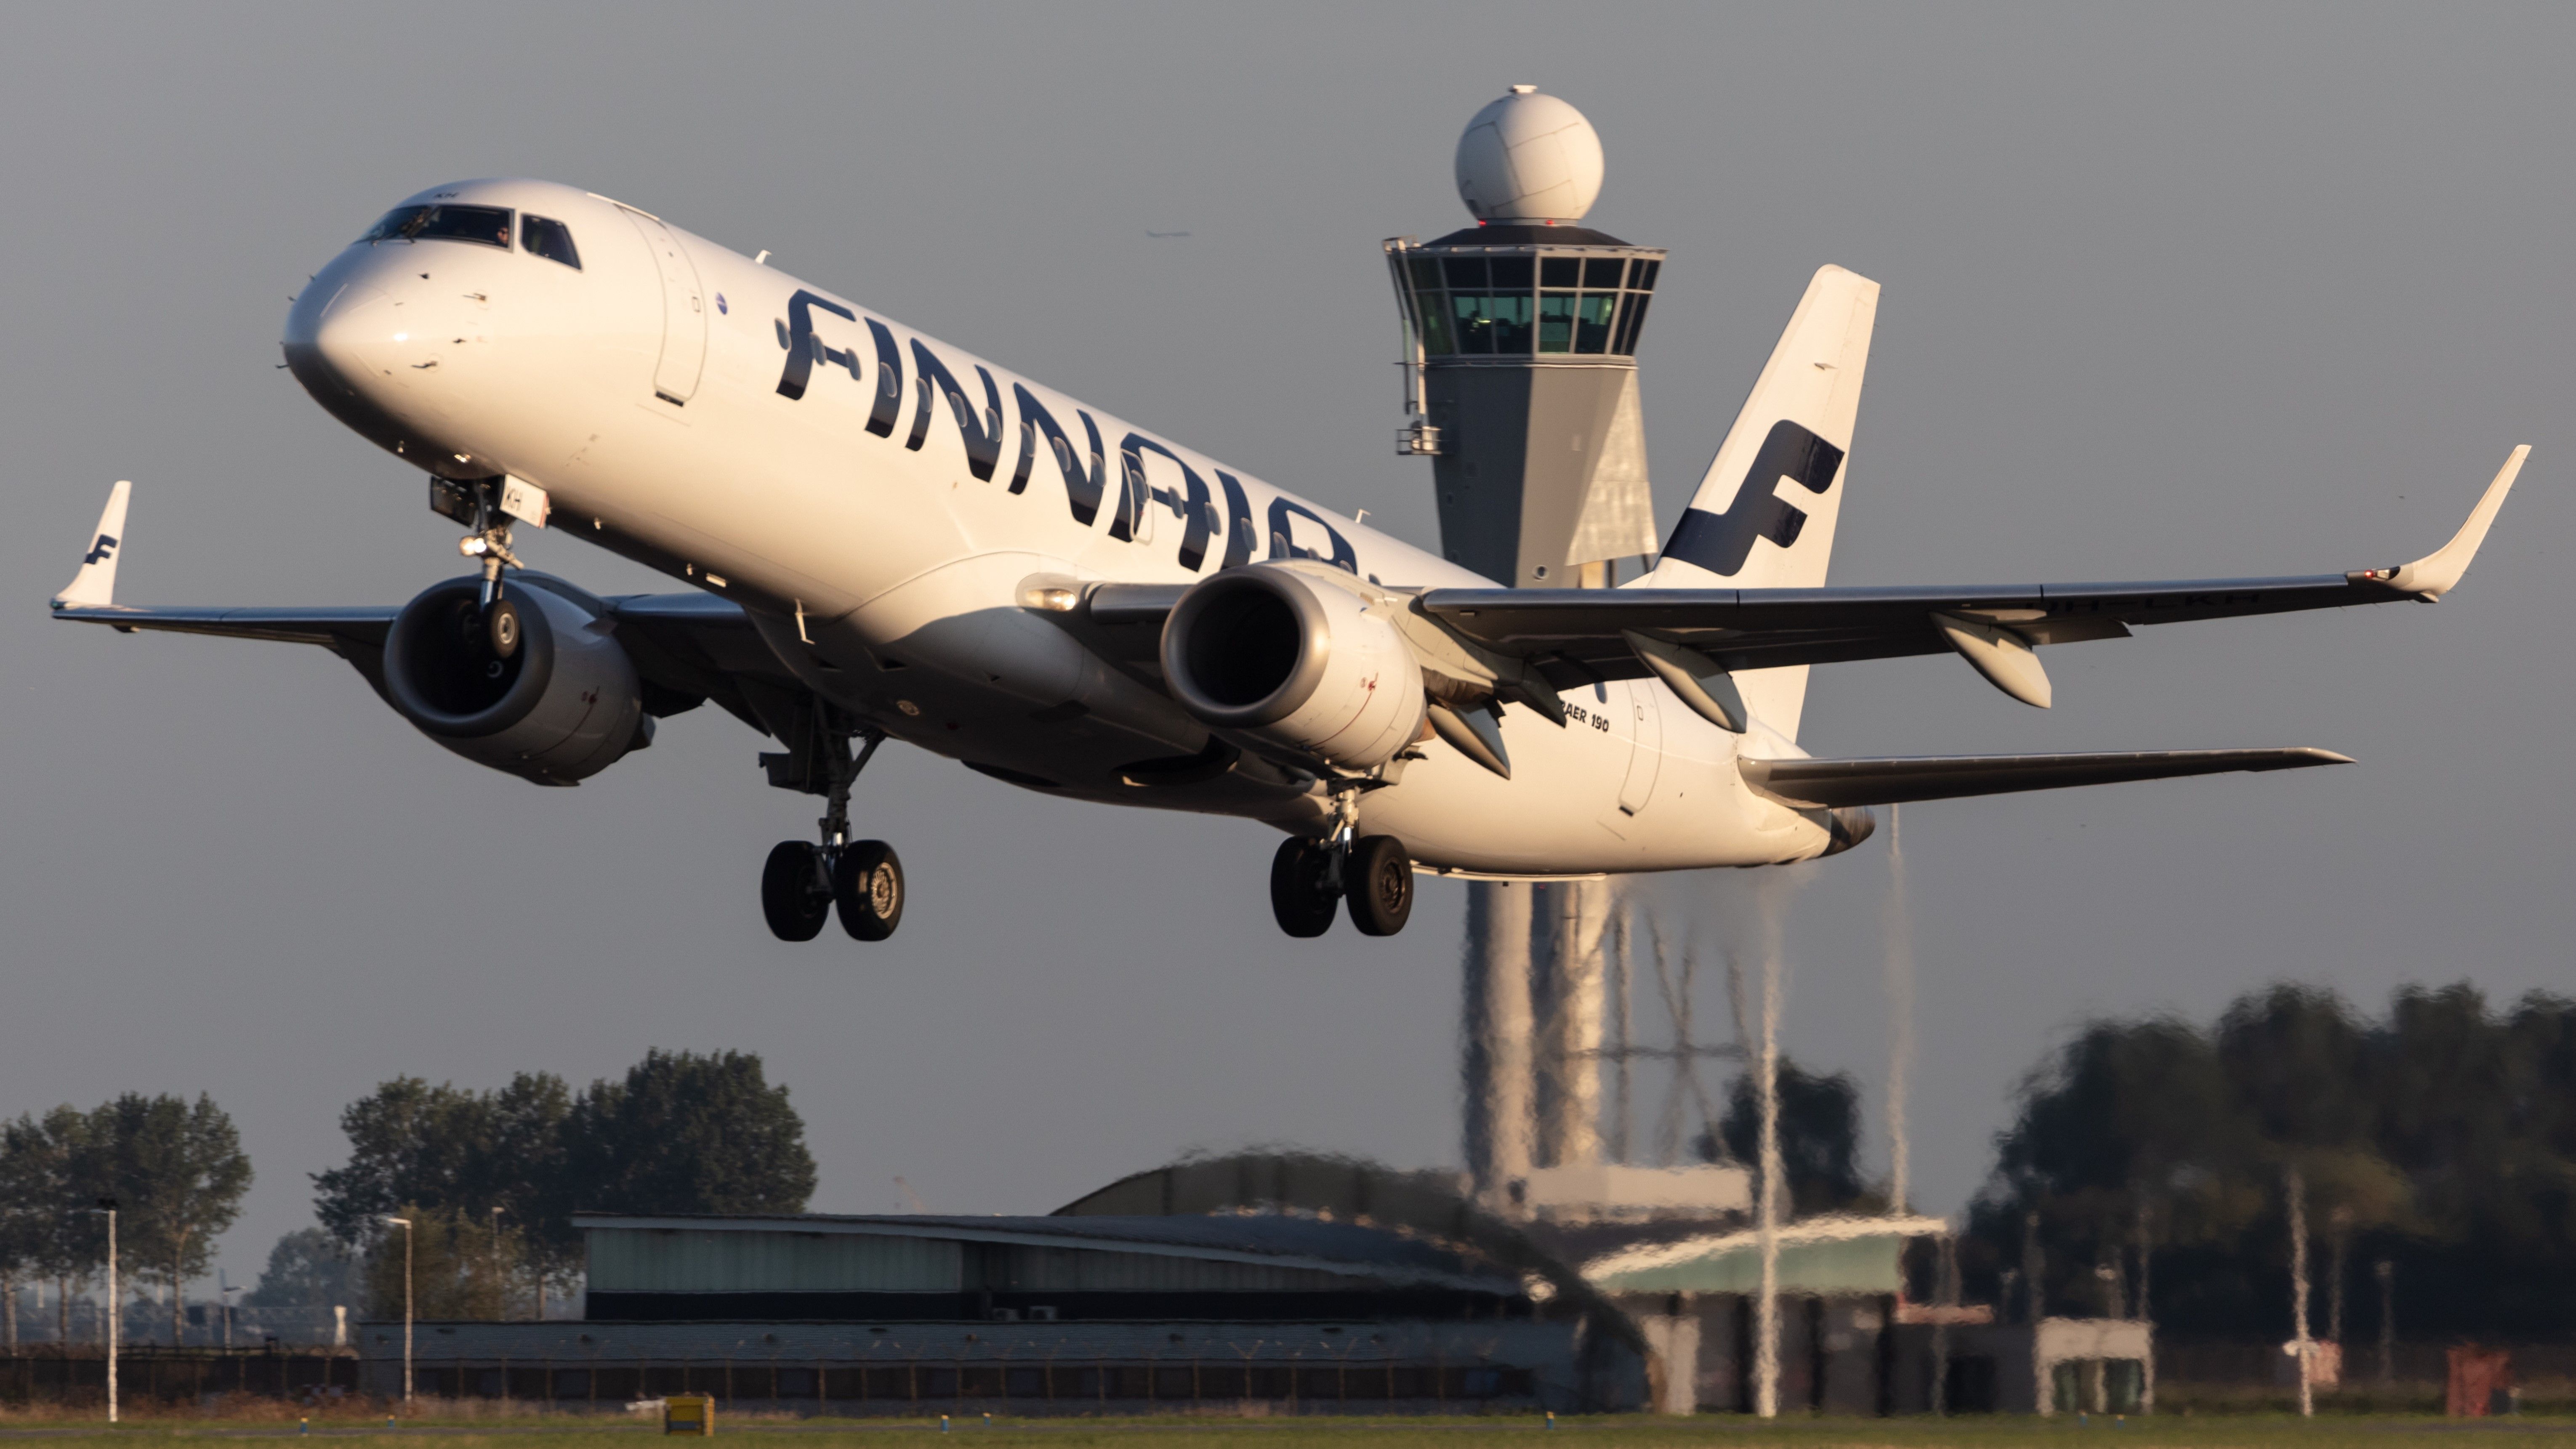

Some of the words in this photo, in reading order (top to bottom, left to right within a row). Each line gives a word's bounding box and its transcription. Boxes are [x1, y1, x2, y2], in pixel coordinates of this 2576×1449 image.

[504, 486, 523, 511] KH
[1661, 419, 1845, 577] F
[85, 534, 117, 565] F
[1591, 714, 1609, 733] 190
